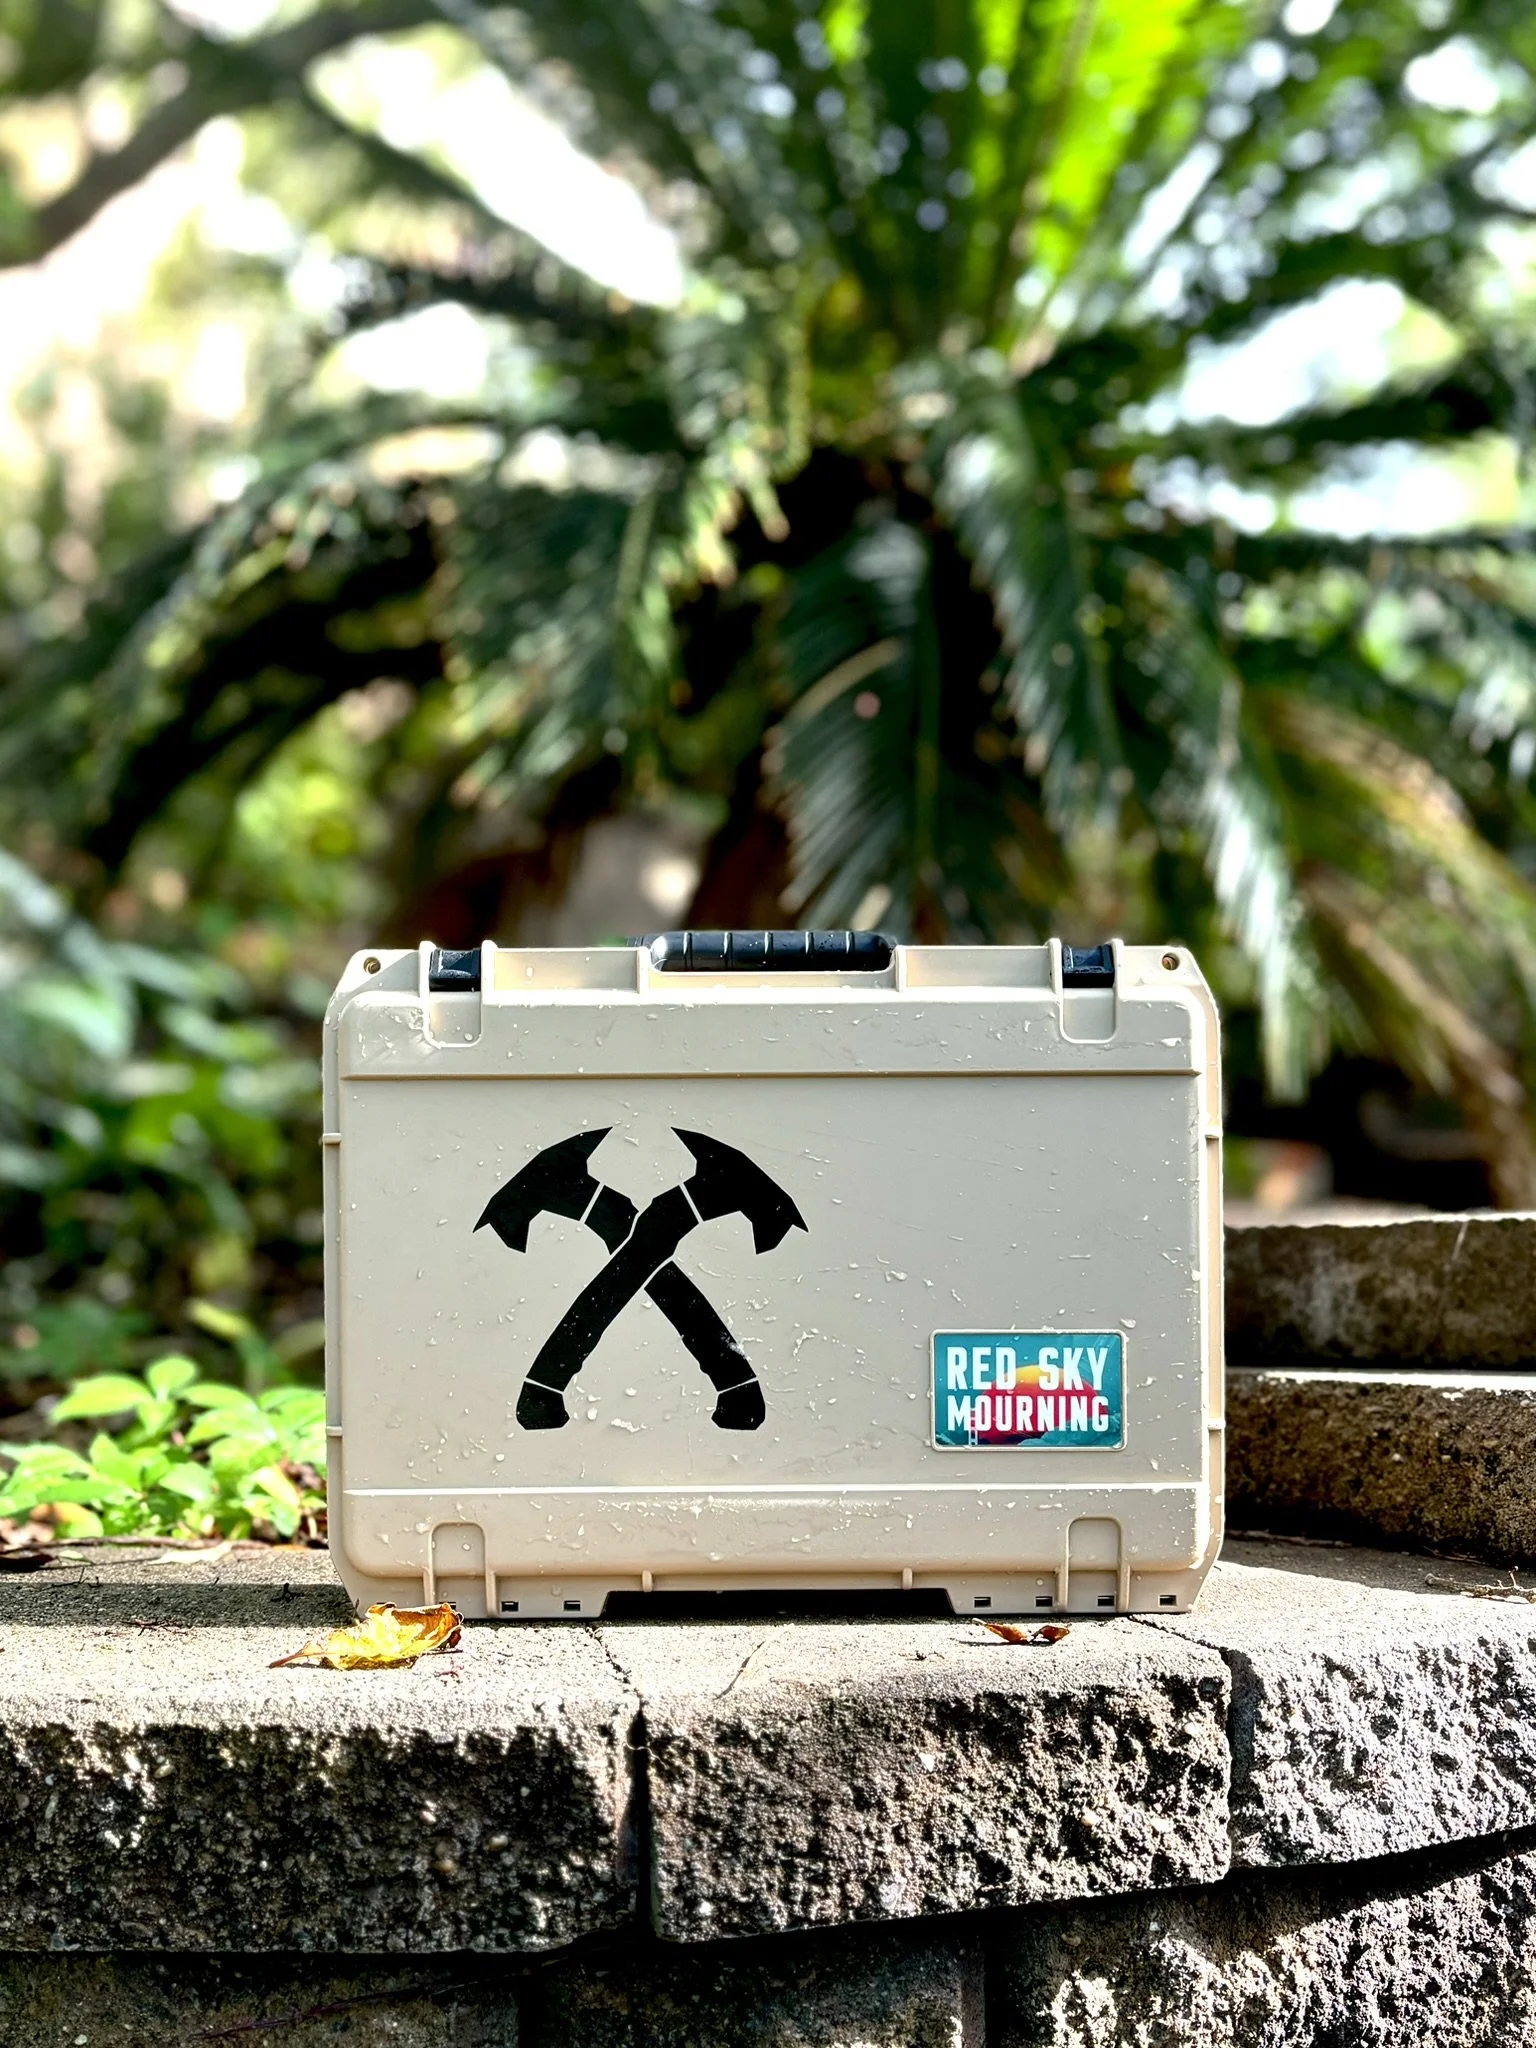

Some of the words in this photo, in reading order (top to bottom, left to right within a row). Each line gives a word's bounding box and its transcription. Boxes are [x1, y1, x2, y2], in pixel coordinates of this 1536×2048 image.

[947, 1346, 1017, 1391] RED
[1038, 1347, 1109, 1391] SKY
[947, 1395, 1109, 1432] MOURNING
